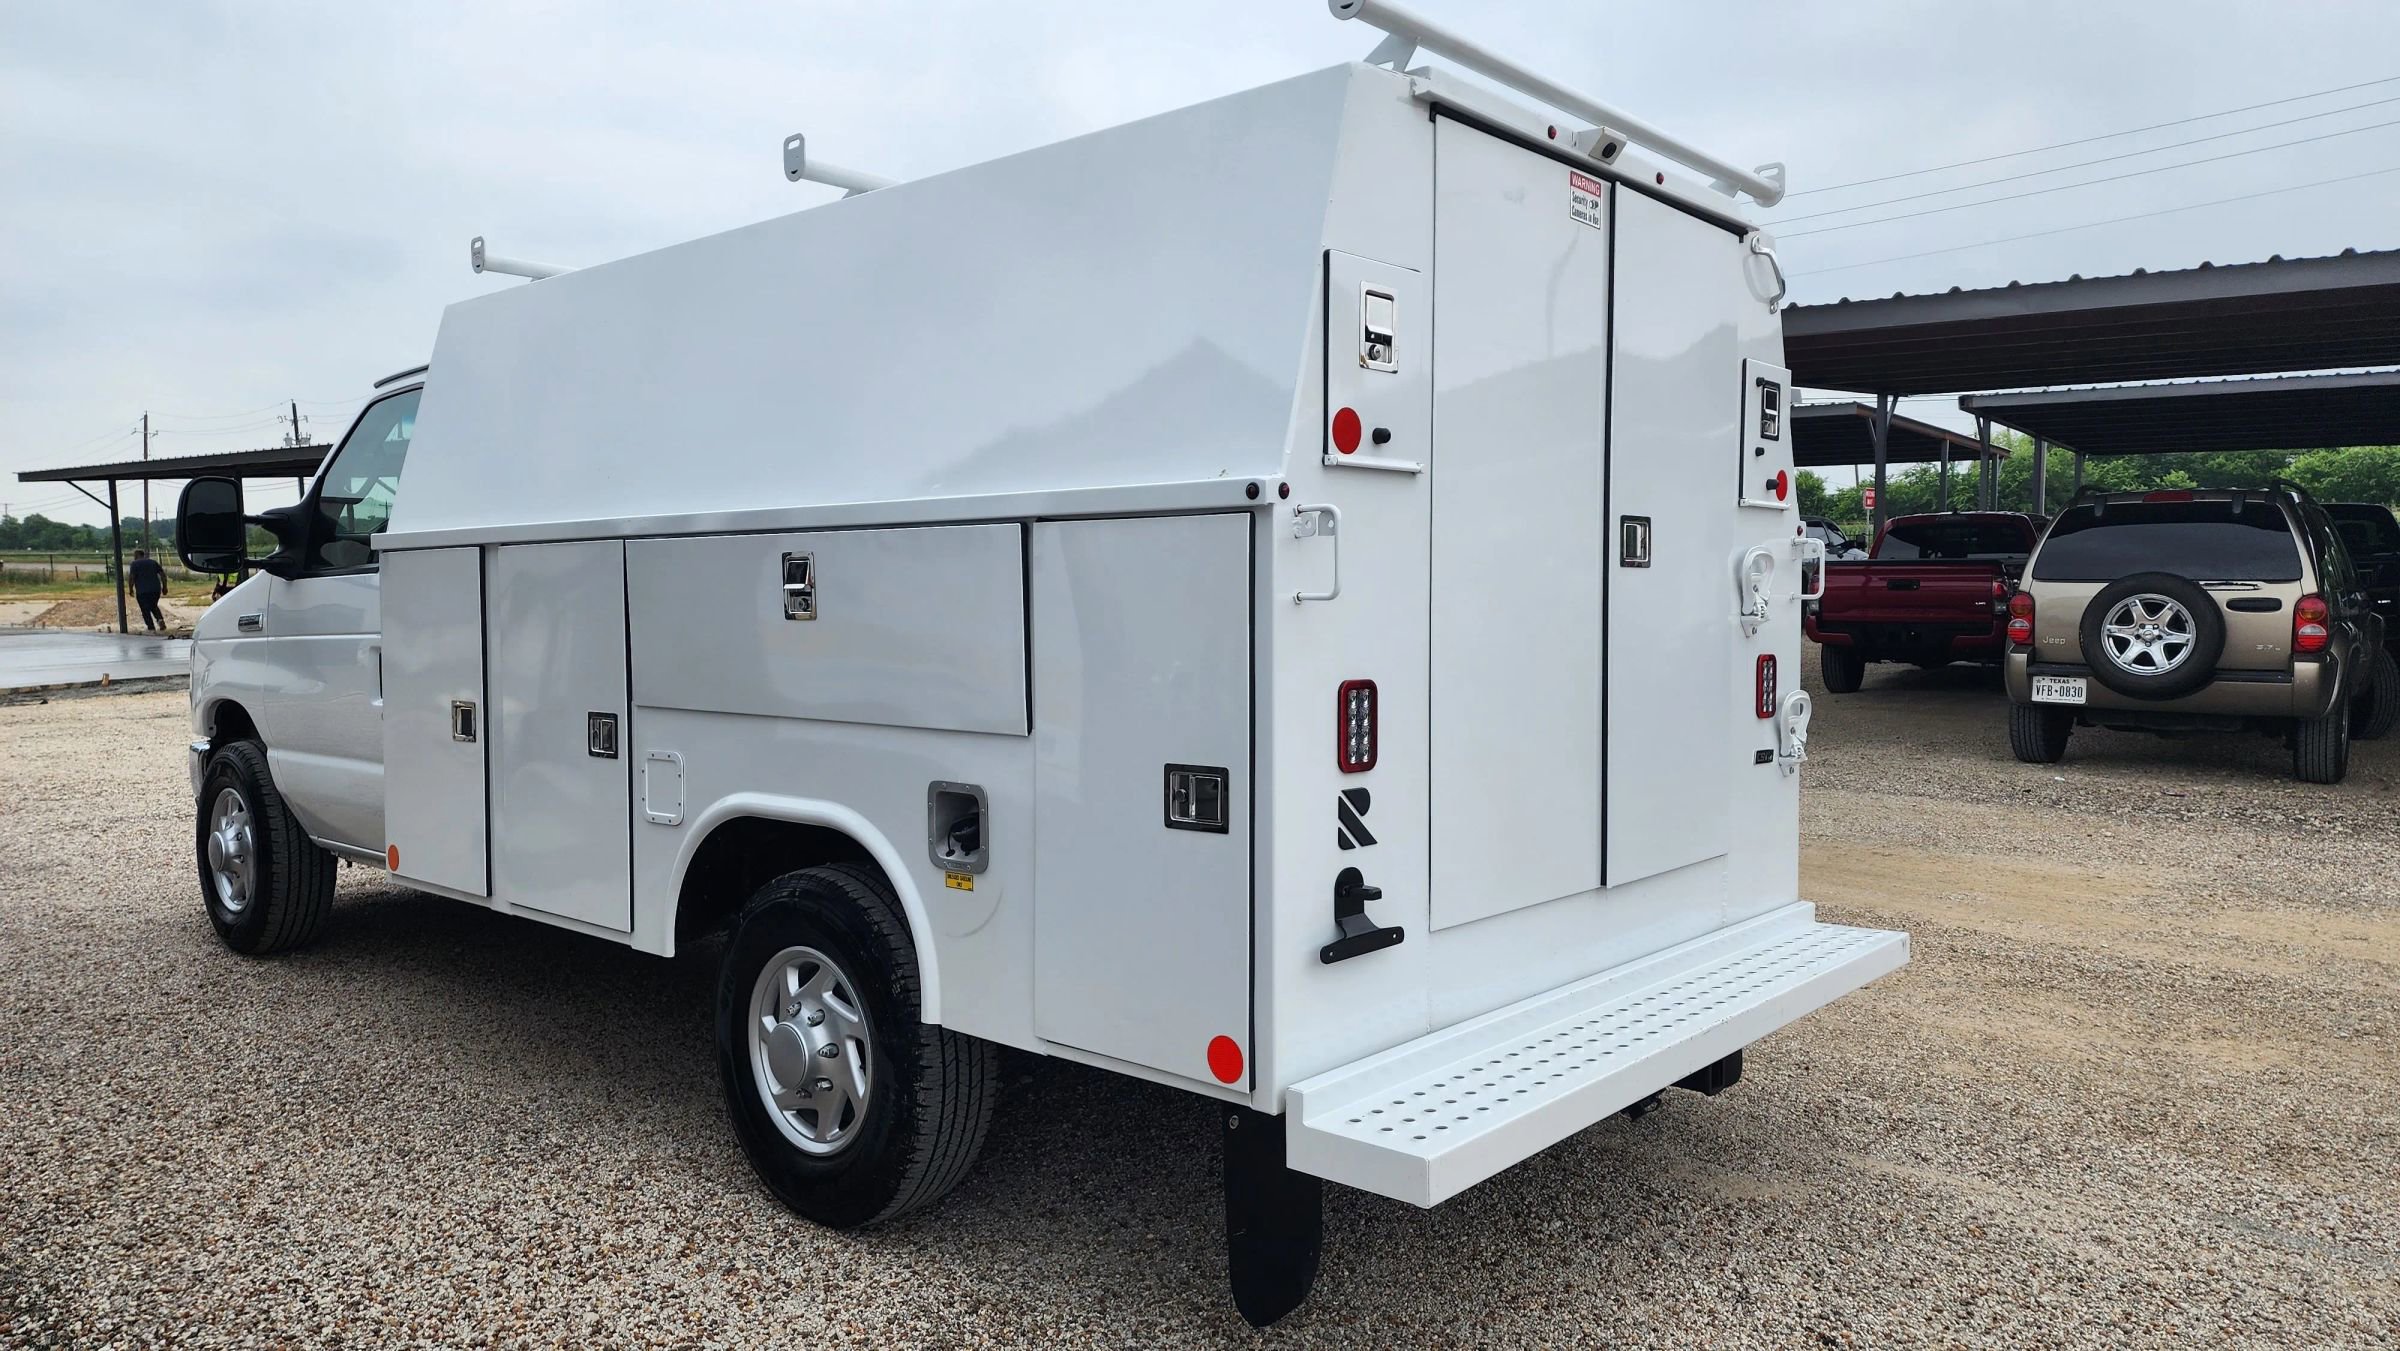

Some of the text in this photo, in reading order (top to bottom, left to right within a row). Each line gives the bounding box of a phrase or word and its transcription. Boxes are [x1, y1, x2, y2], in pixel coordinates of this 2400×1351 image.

[1571, 173, 1600, 196] WARNING
[1572, 190, 1589, 210] Security
[1572, 205, 1588, 221] Cameras
[2042, 636, 2066, 645] Jeep
